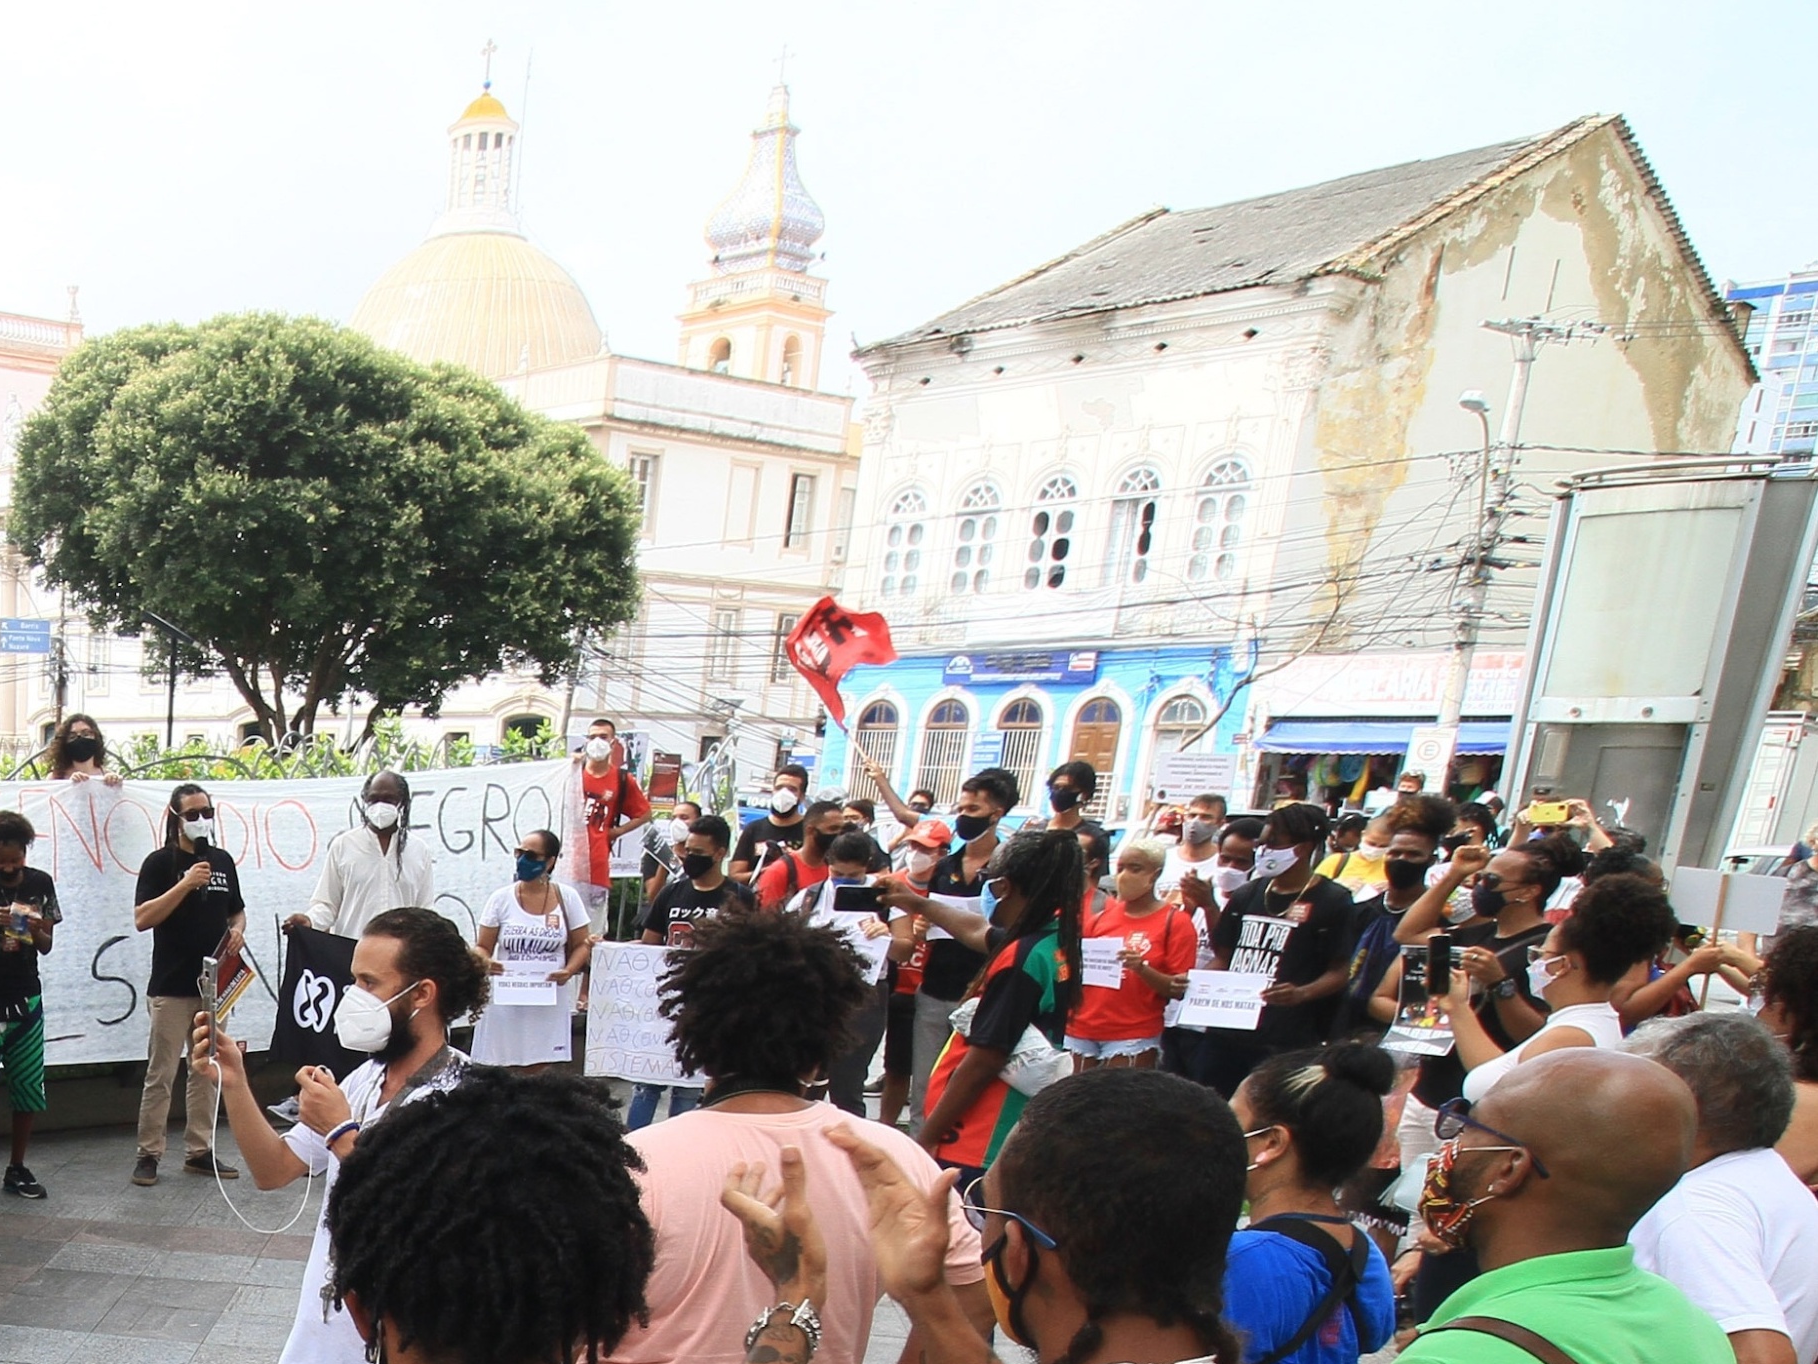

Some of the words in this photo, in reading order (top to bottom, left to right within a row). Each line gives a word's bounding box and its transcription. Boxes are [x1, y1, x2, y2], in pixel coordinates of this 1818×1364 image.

[1188, 997, 1210, 1006] PAREM
[1211, 998, 1219, 1007] DE
[585, 1050, 677, 1075] SISTEMA
